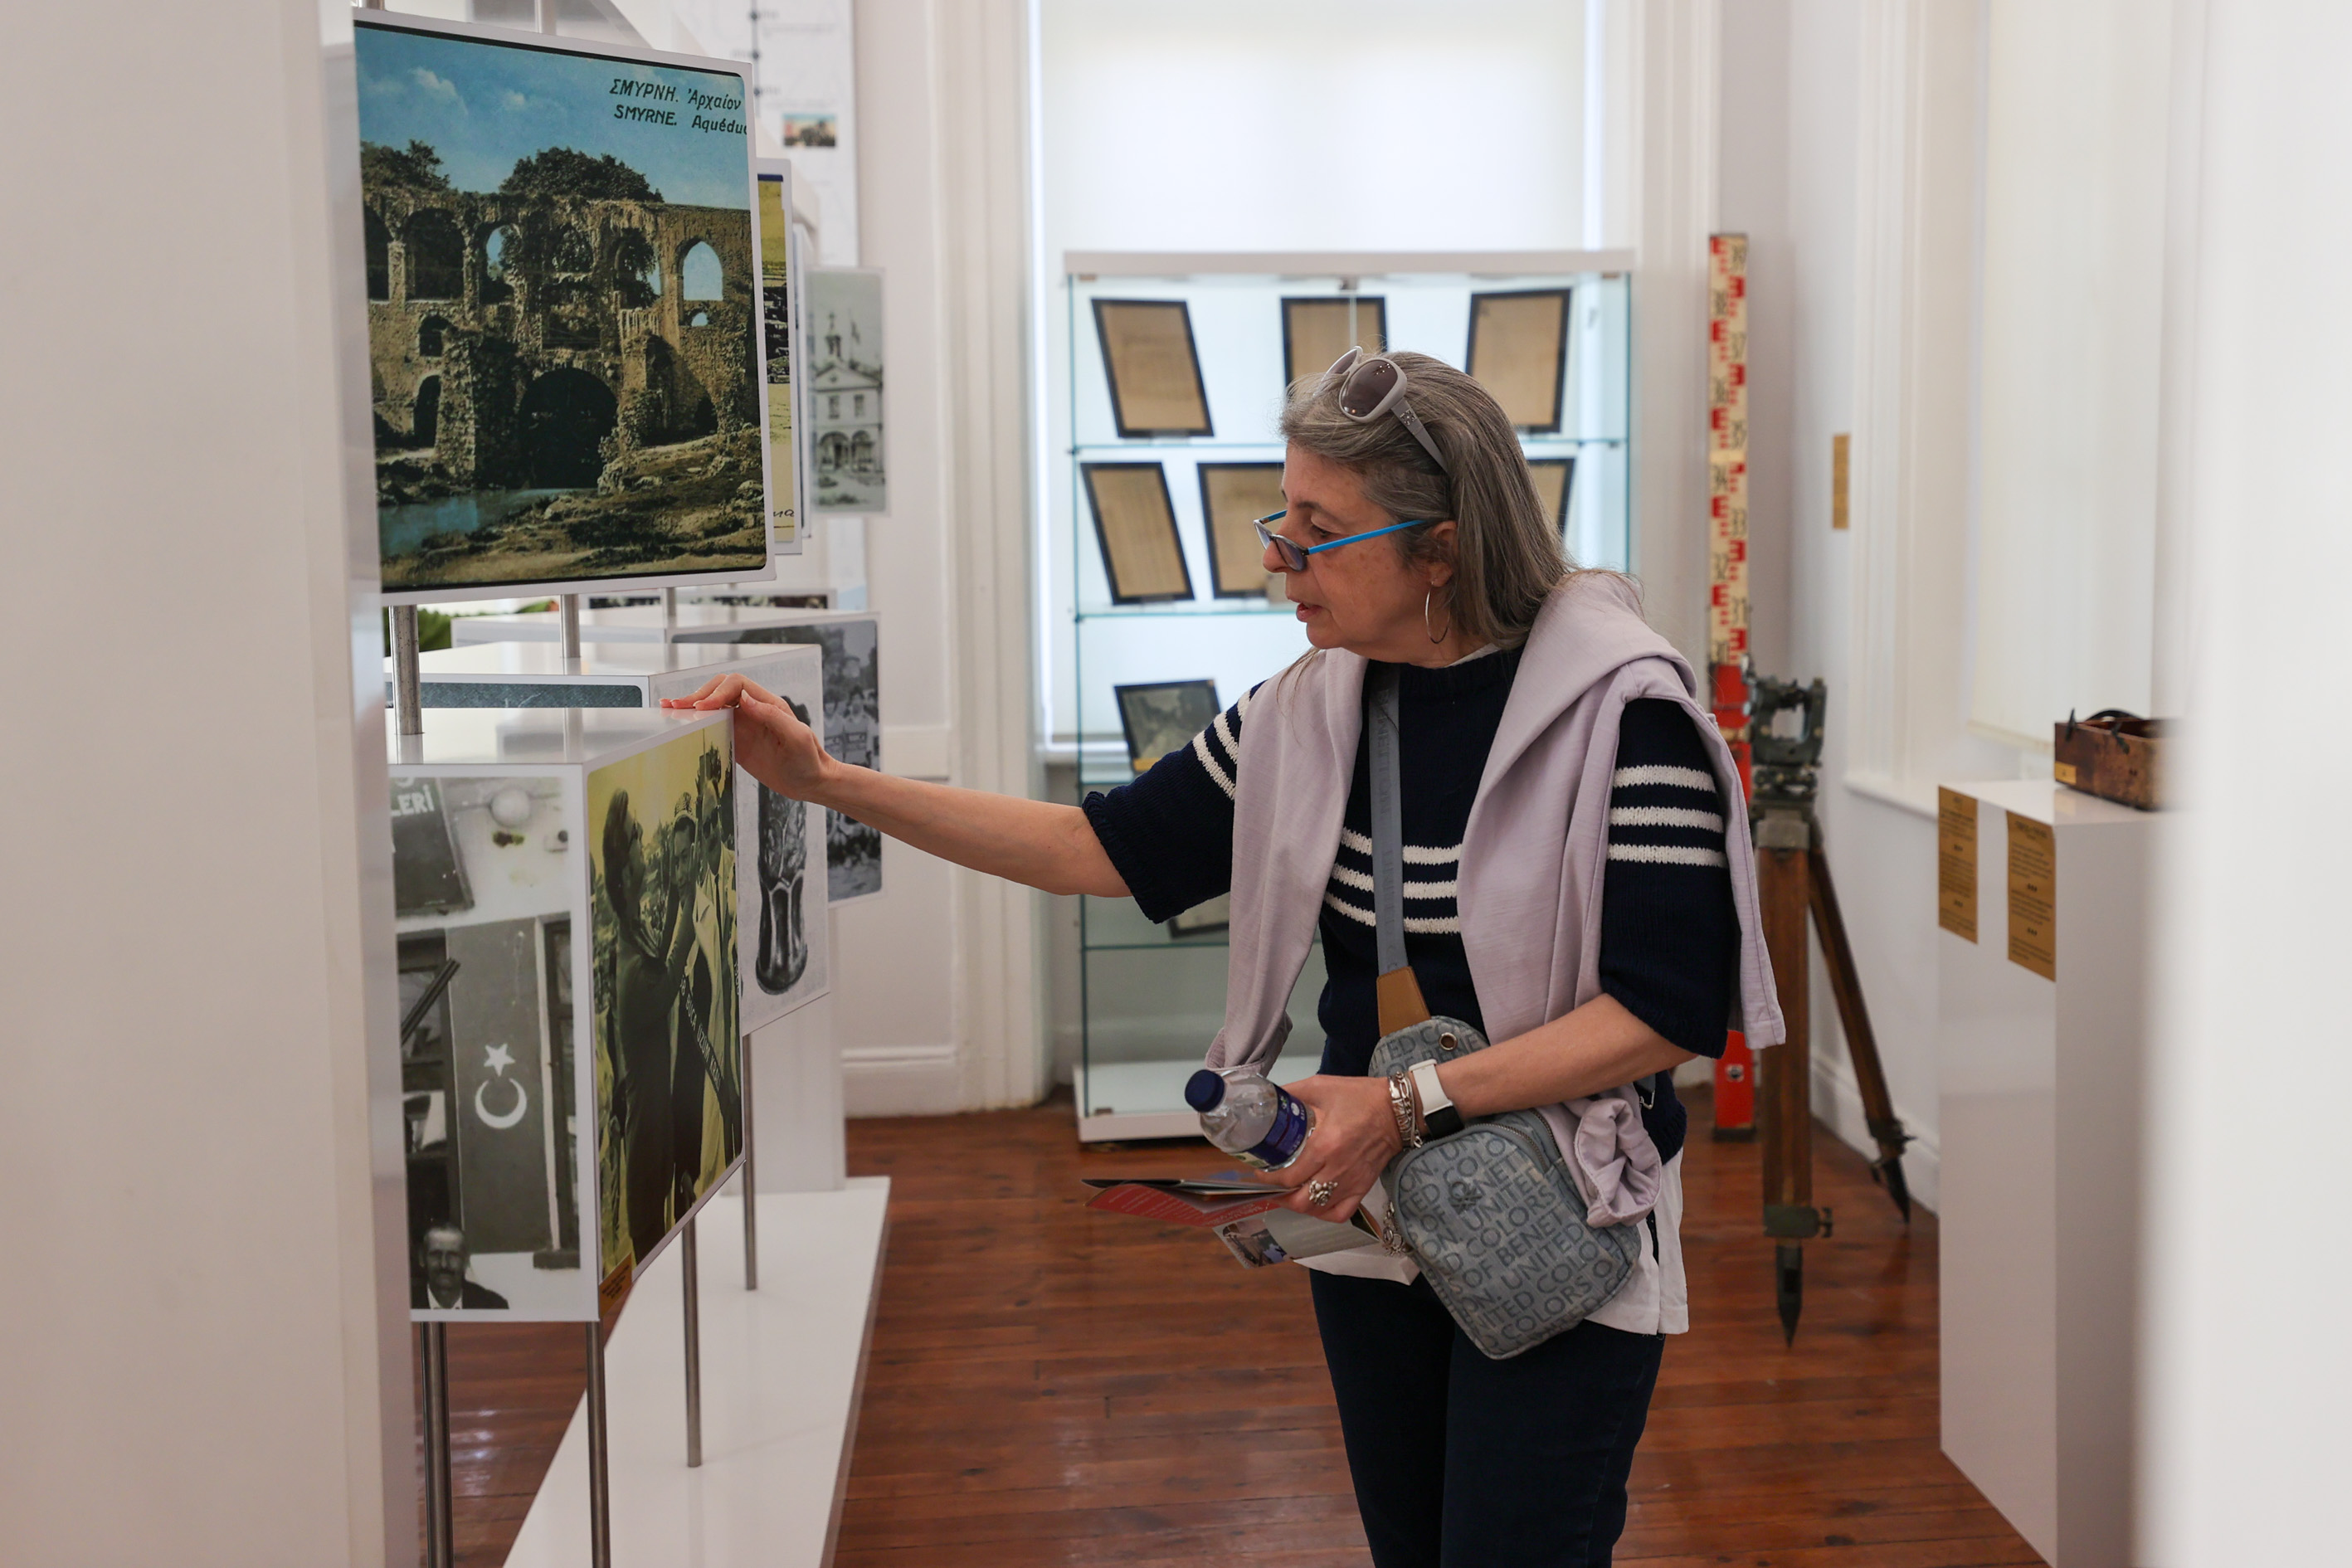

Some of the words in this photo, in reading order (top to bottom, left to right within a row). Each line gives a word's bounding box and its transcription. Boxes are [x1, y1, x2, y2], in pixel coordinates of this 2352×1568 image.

[613, 104, 678, 126] SMYRNE.
[1466, 1184, 1557, 1258] COLORS
[1463, 1258, 1493, 1288] OF
[1501, 1222, 1585, 1290] UNITED
[1501, 1274, 1592, 1339] COLORS
